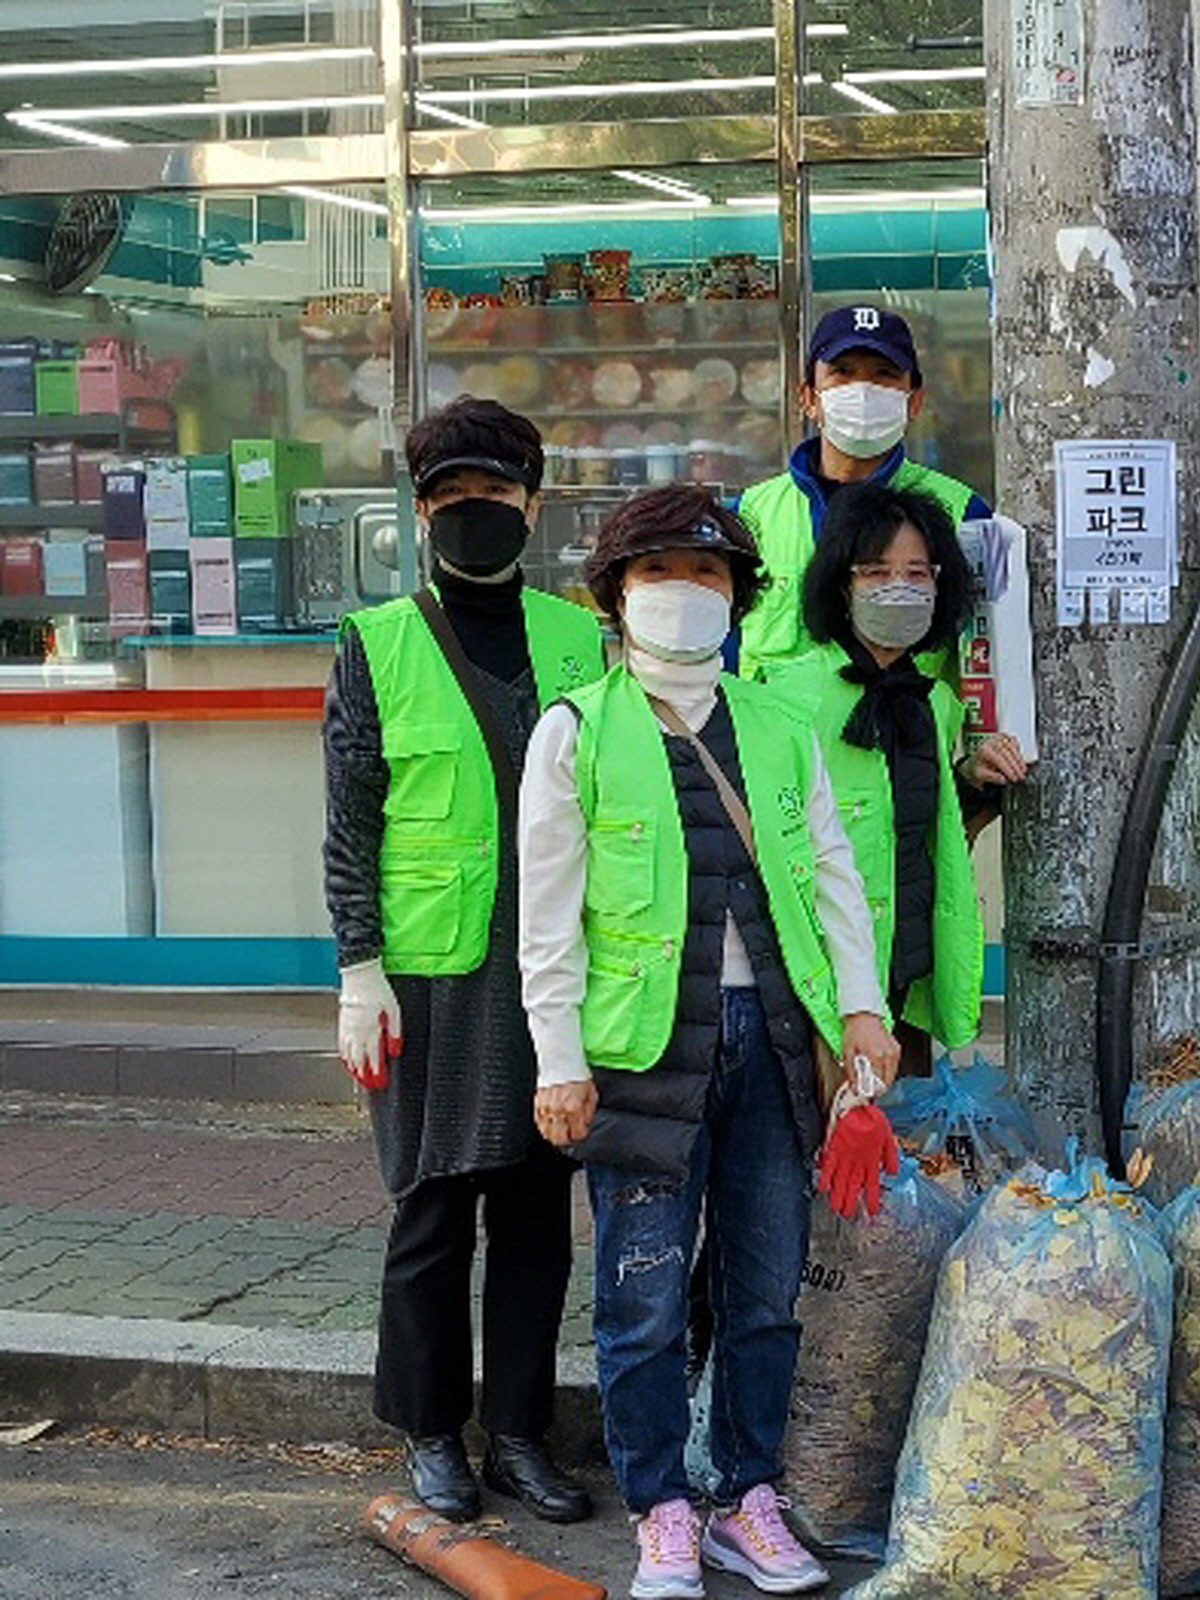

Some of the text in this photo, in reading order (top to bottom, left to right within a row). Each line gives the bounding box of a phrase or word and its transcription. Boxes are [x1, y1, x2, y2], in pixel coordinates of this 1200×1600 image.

[853, 307, 880, 330] D
[1085, 466, 1146, 496] 그린
[1086, 506, 1148, 537] 파크
